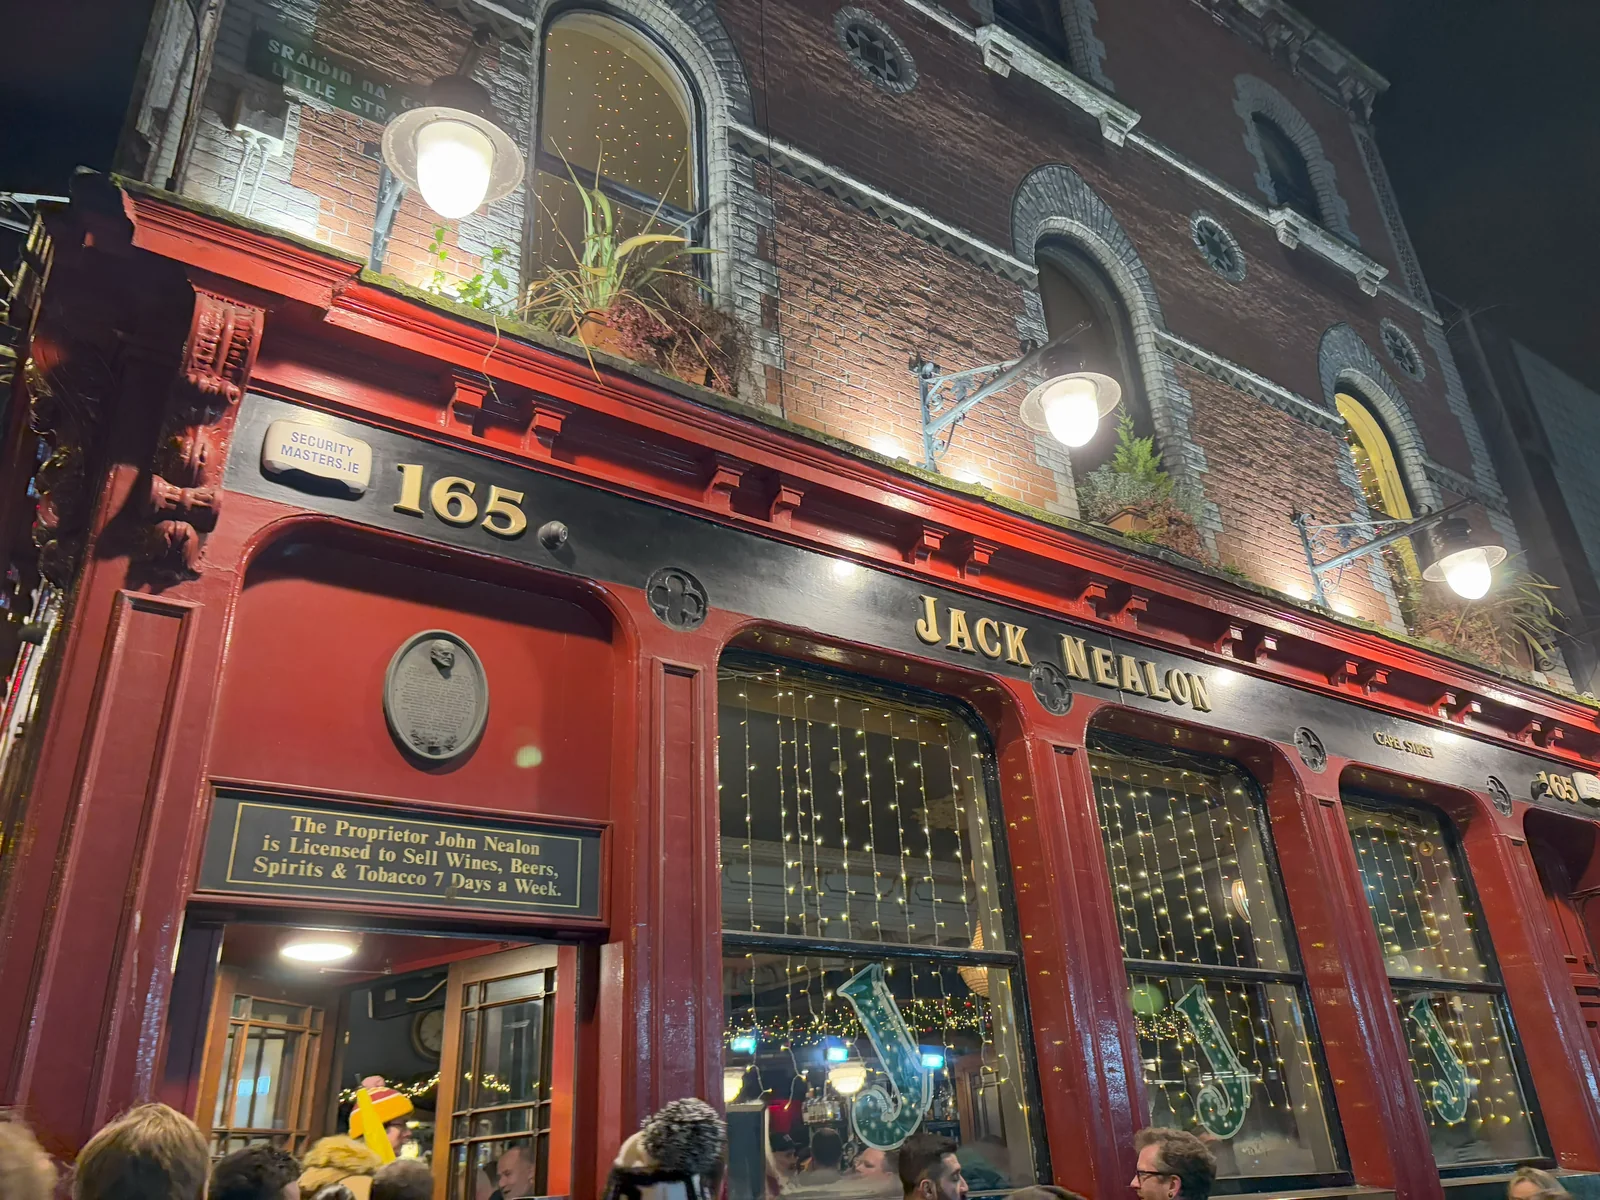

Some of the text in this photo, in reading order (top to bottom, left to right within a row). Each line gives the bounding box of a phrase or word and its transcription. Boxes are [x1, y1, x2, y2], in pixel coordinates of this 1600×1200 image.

[272, 62, 337, 100] LITTLE
[351, 95, 400, 125] STRA
[280, 444, 360, 474] MASTERS.IE
[290, 431, 354, 457] SECURITY
[392, 462, 529, 537] 165
[914, 593, 1213, 713] JACK NEALON
[1535, 770, 1579, 804] 165
[290, 815, 541, 856] The Proprietor John Nealon
[253, 856, 562, 897] Spirits & Tobacco 7 Days a Week.
[262, 834, 559, 880] is Licensed to Sell Wines, Beers,
